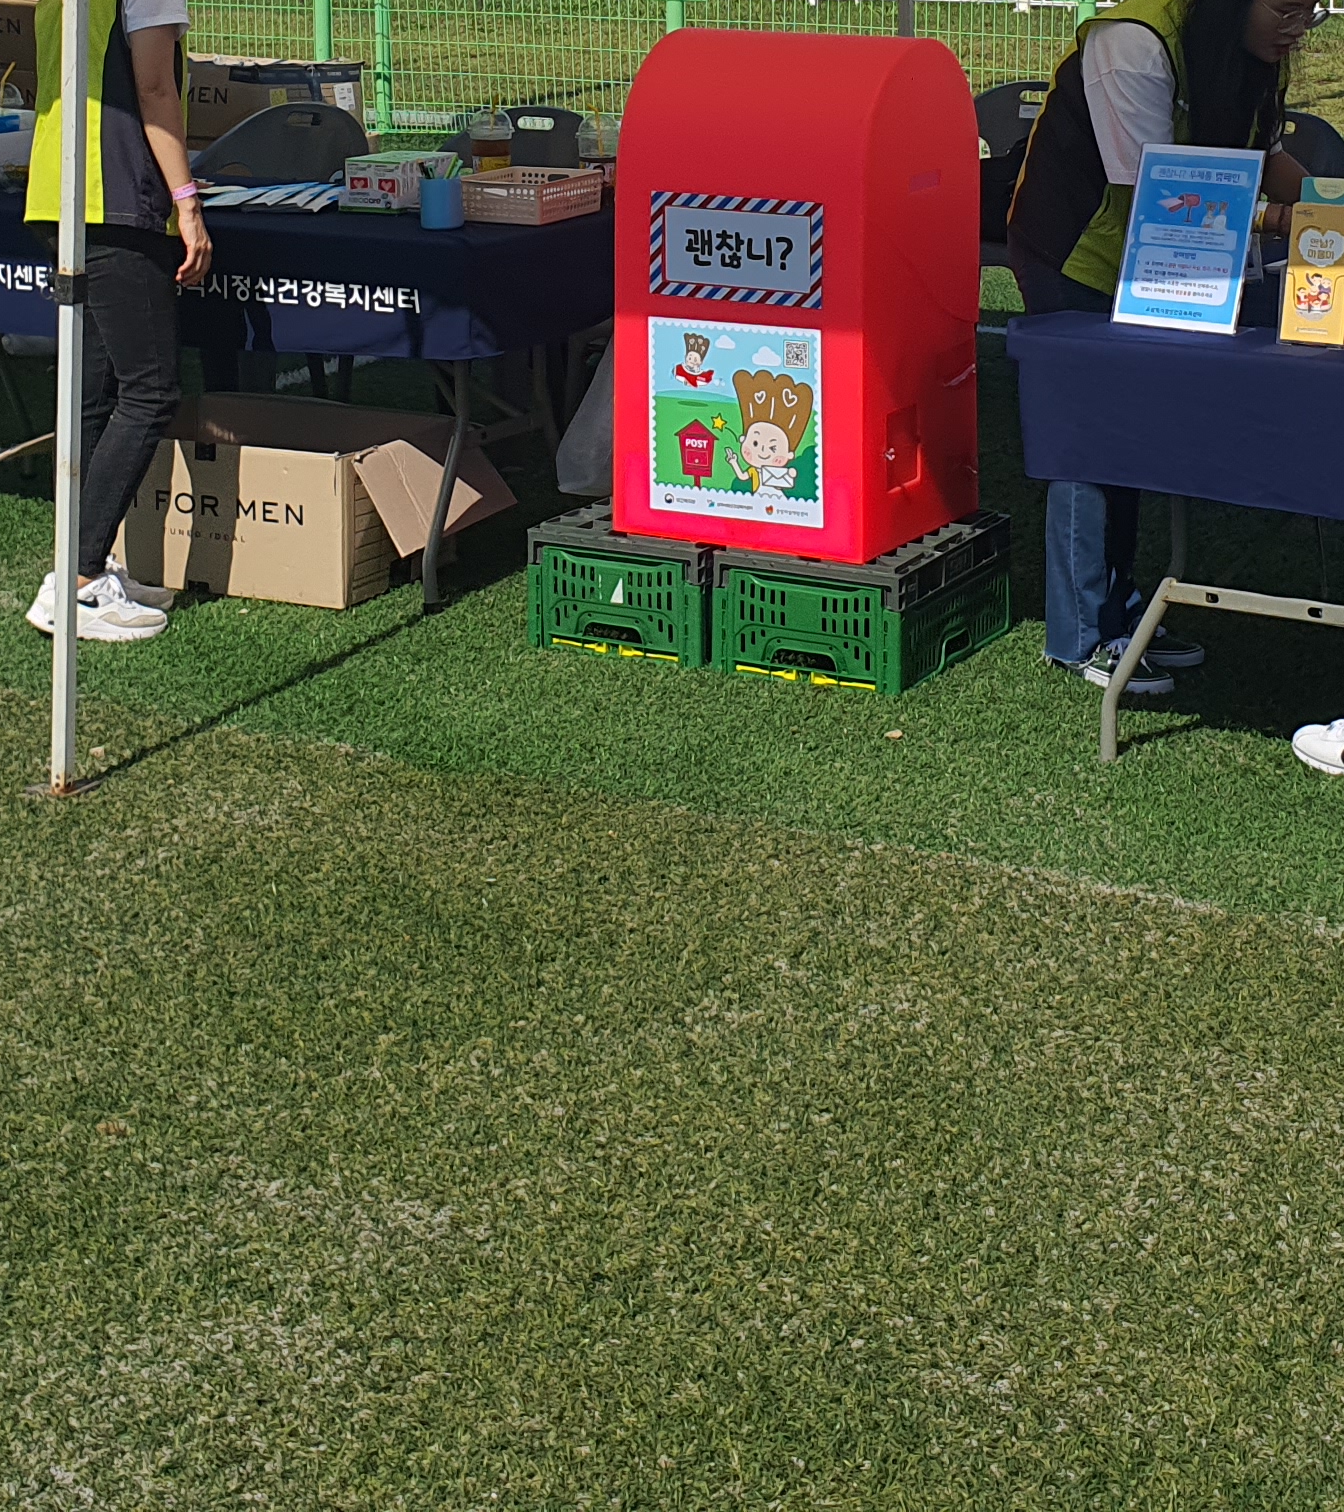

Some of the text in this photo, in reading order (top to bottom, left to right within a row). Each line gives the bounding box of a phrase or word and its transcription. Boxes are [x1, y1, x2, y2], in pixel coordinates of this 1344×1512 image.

[684, 228, 794, 271] 괜찮니?
[177, 273, 421, 314] 시정신건강복지센터
[685, 438, 709, 449] POST
[155, 489, 219, 517] FOR
[236, 498, 304, 526] MEN
